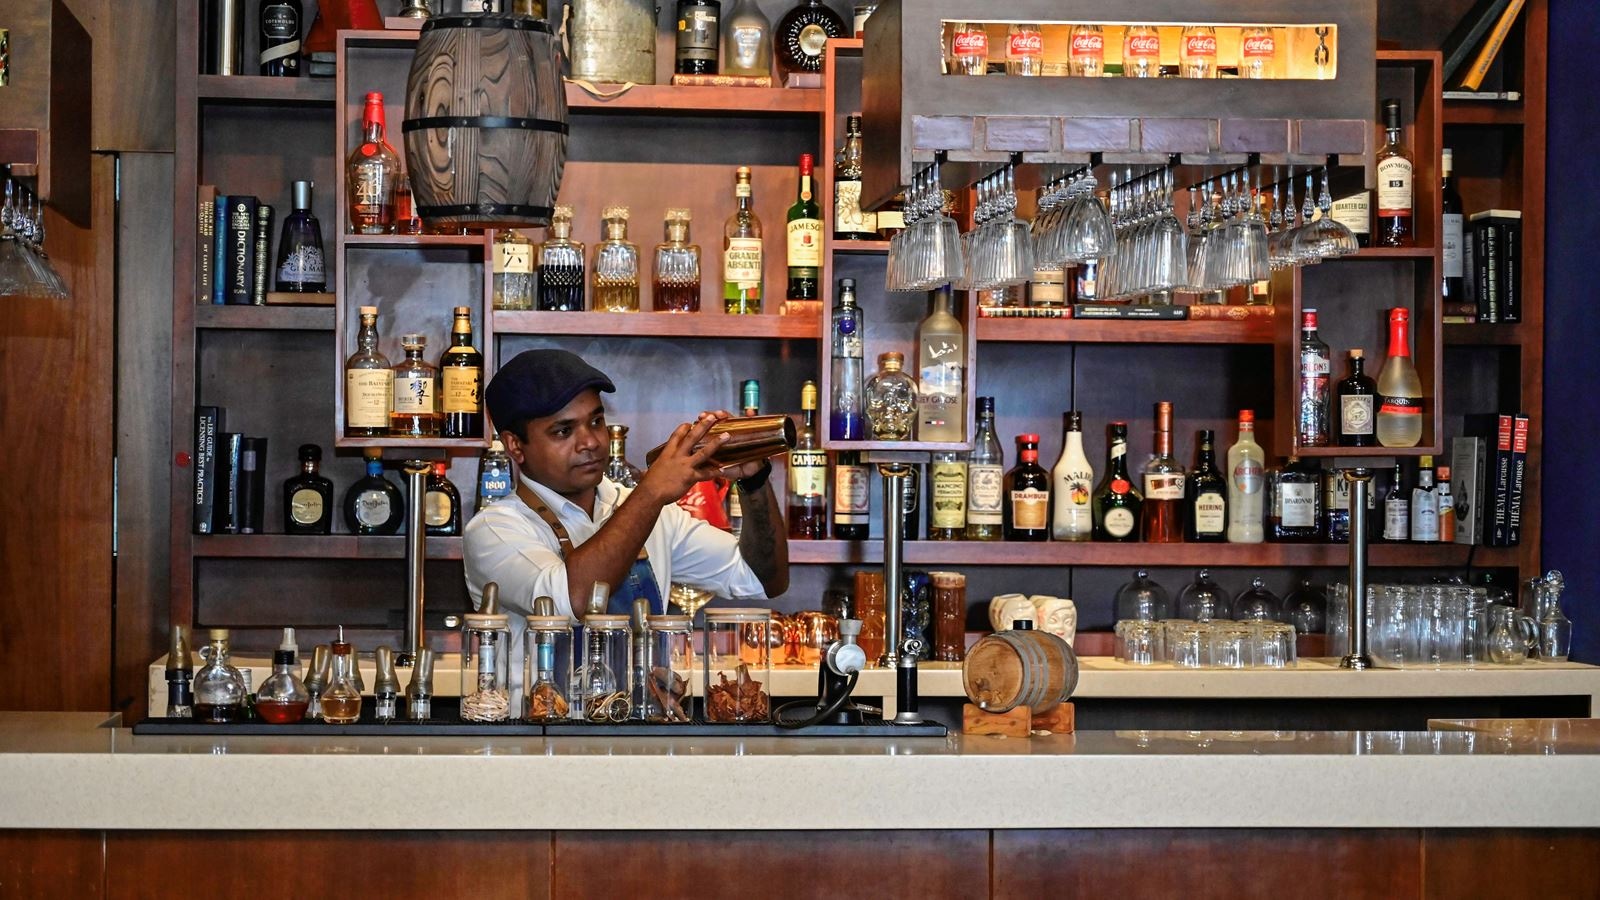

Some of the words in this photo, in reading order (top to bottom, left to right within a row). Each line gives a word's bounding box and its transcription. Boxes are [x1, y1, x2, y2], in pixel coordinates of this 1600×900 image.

[790, 223, 822, 233] JAMESO
[236, 230, 246, 287] DICTIONARY
[729, 252, 760, 260] GRANDE
[792, 454, 828, 466] CAMPAR
[1064, 472, 1092, 484] MALIB
[1512, 460, 1524, 494] Larousse
[485, 481, 506, 490] 1800
